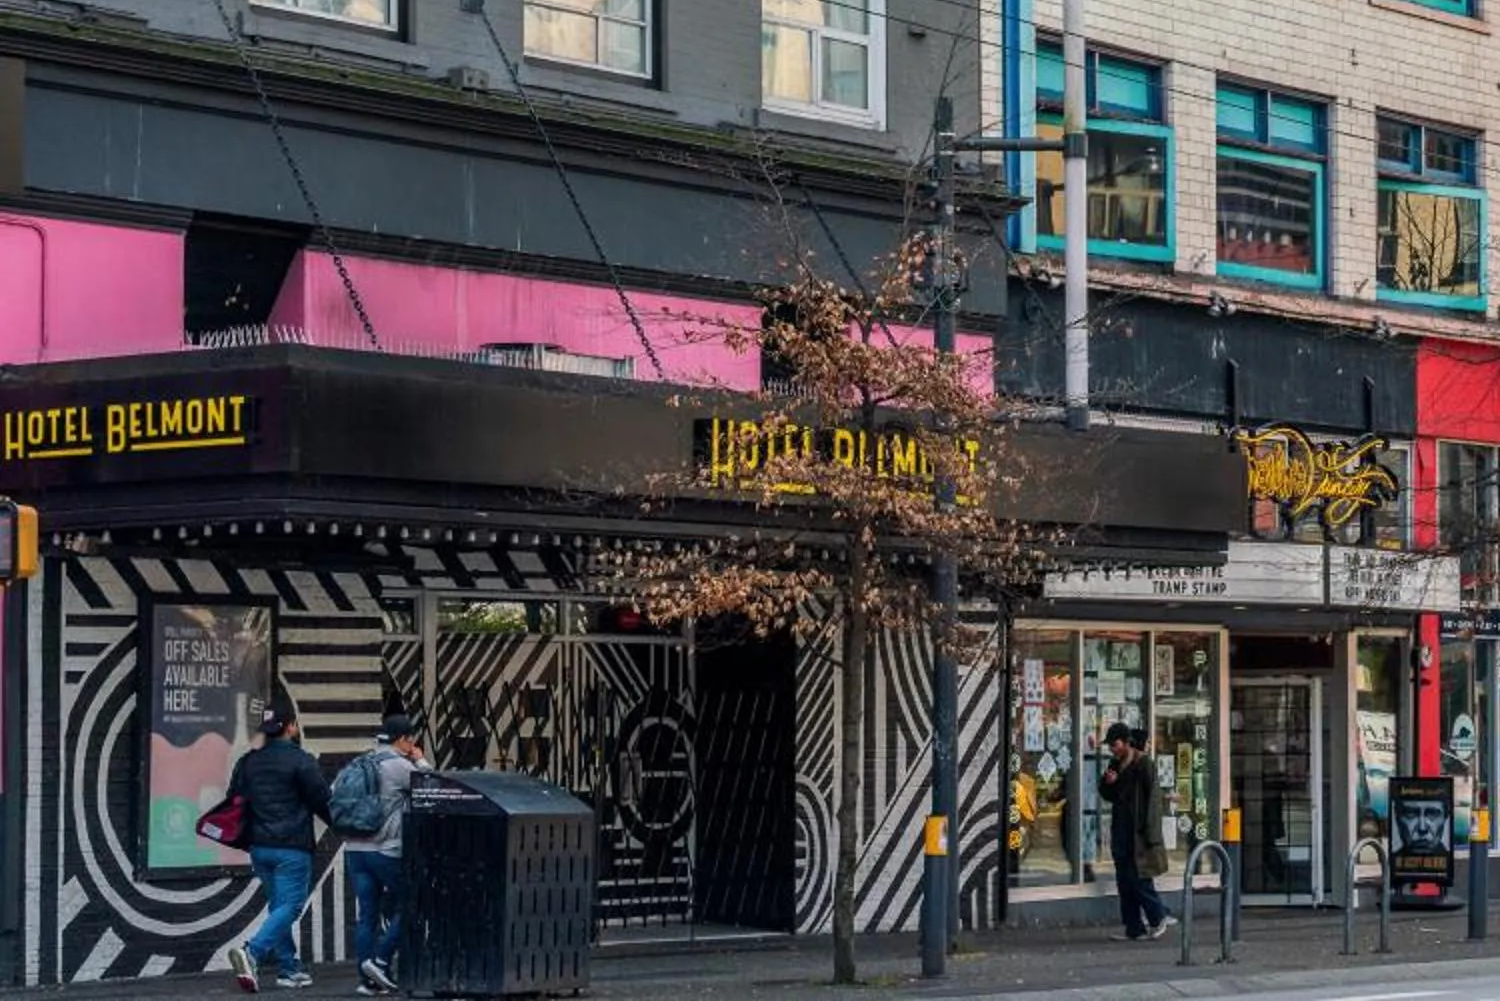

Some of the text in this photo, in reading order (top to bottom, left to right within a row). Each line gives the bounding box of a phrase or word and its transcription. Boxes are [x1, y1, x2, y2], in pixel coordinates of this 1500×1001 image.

[5, 395, 245, 460] HOTEL BELMONT
[832, 426, 980, 485] BLMT
[164, 640, 230, 662] OFF SALES
[163, 664, 231, 687] AVAILABLE
